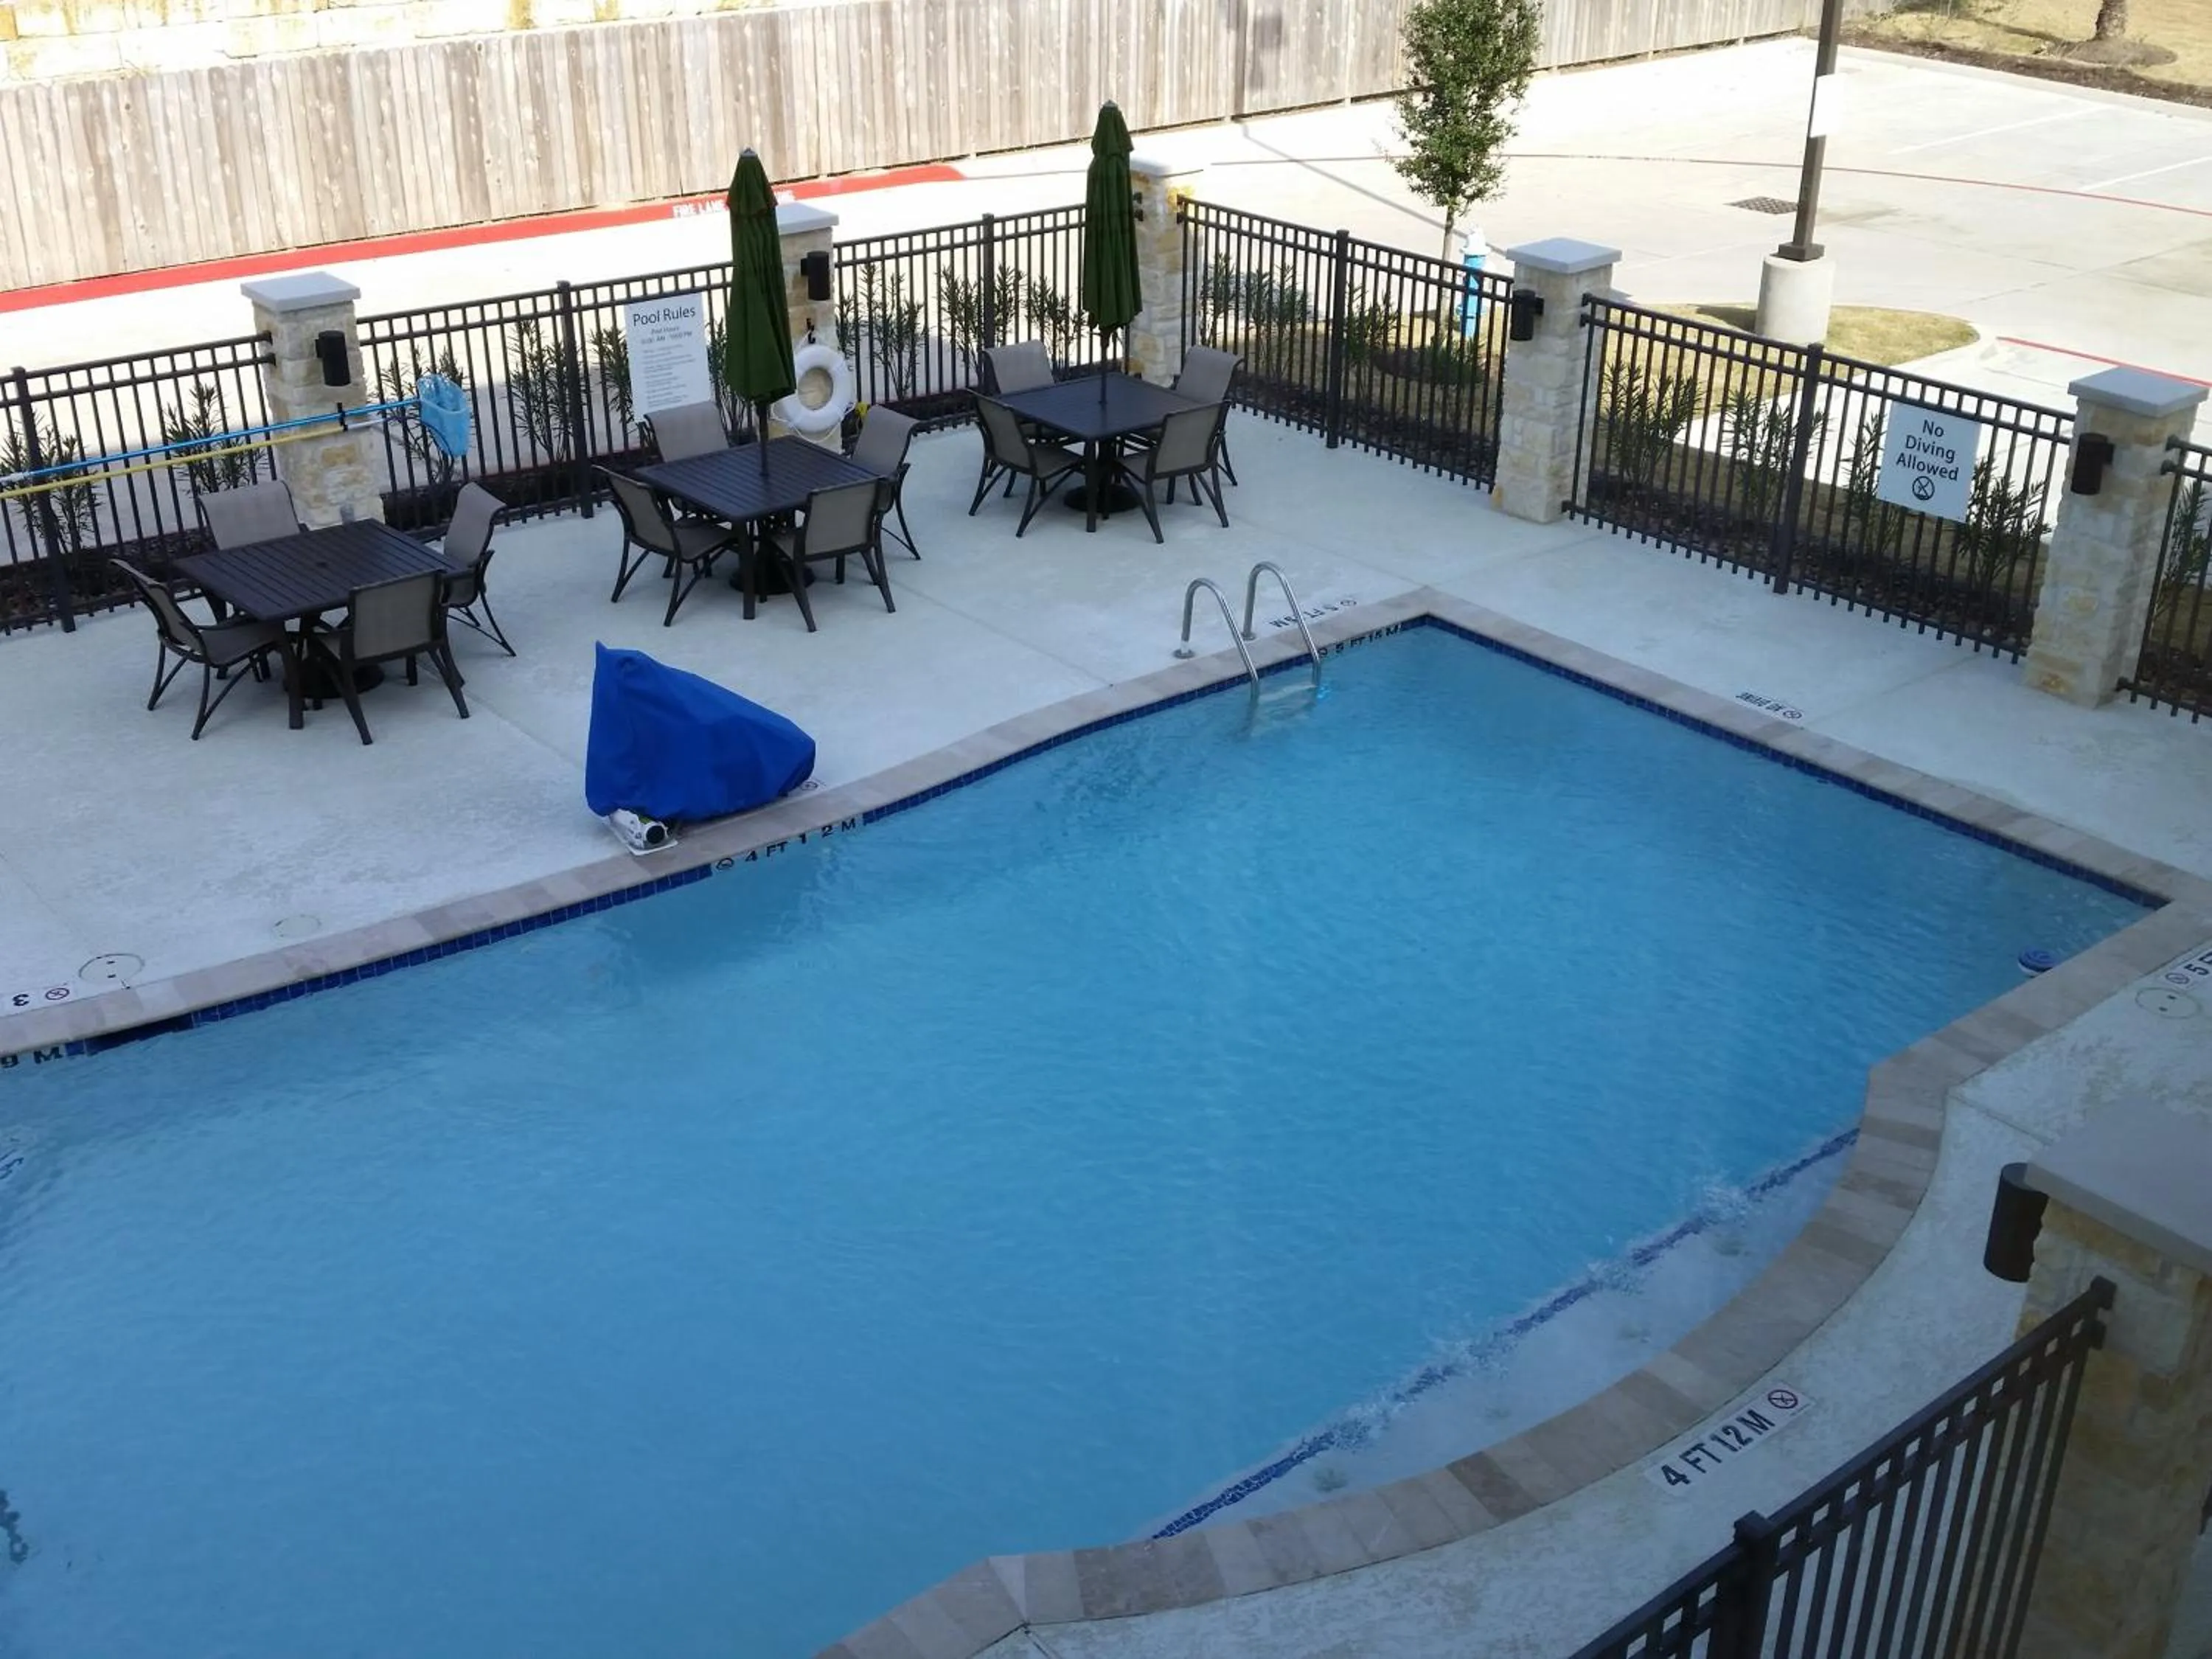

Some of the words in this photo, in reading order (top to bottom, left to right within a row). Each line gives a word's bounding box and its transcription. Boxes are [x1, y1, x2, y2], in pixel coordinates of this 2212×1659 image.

[633, 310, 660, 327] Pool
[664, 306, 696, 321] Rules
[1922, 419, 1944, 437] No
[1905, 434, 1956, 465] Diving
[1896, 452, 1959, 481] Allowed
[745, 850, 758, 862] 4
[766, 841, 789, 858] FT
[841, 818, 856, 832] M
[33, 1046, 63, 1064] M
[1661, 1463, 1691, 1486] 4
[1679, 1442, 1722, 1474] FT
[1736, 1409, 1775, 1435] M
